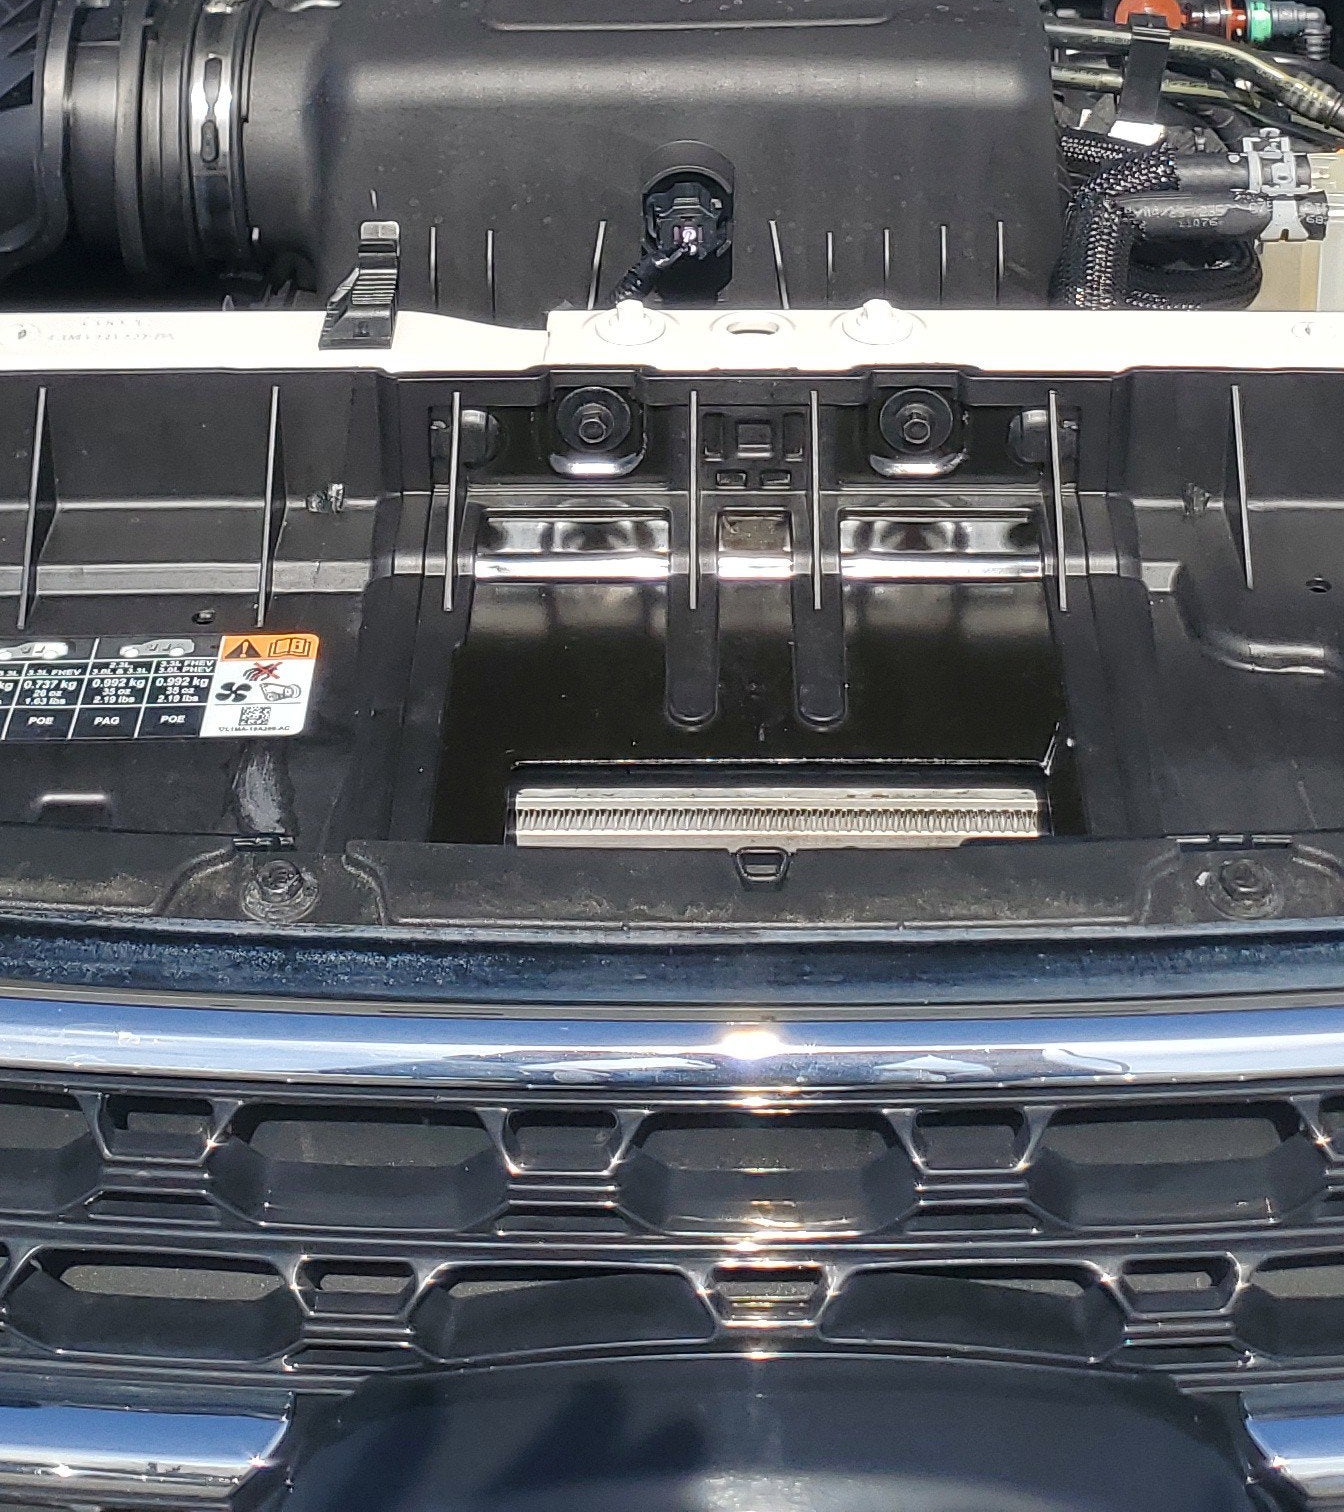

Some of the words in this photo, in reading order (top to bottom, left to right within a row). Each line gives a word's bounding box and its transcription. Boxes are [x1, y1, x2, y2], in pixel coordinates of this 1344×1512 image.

[23, 680, 58, 690] 0.737
[59, 679, 78, 691] kg
[128, 678, 146, 689] kg
[156, 677, 190, 687] 0.992
[192, 676, 210, 688] kg
[117, 696, 135, 704] lbs
[27, 716, 55, 726] POE
[93, 716, 120, 726] PAG
[159, 714, 186, 724] POE
